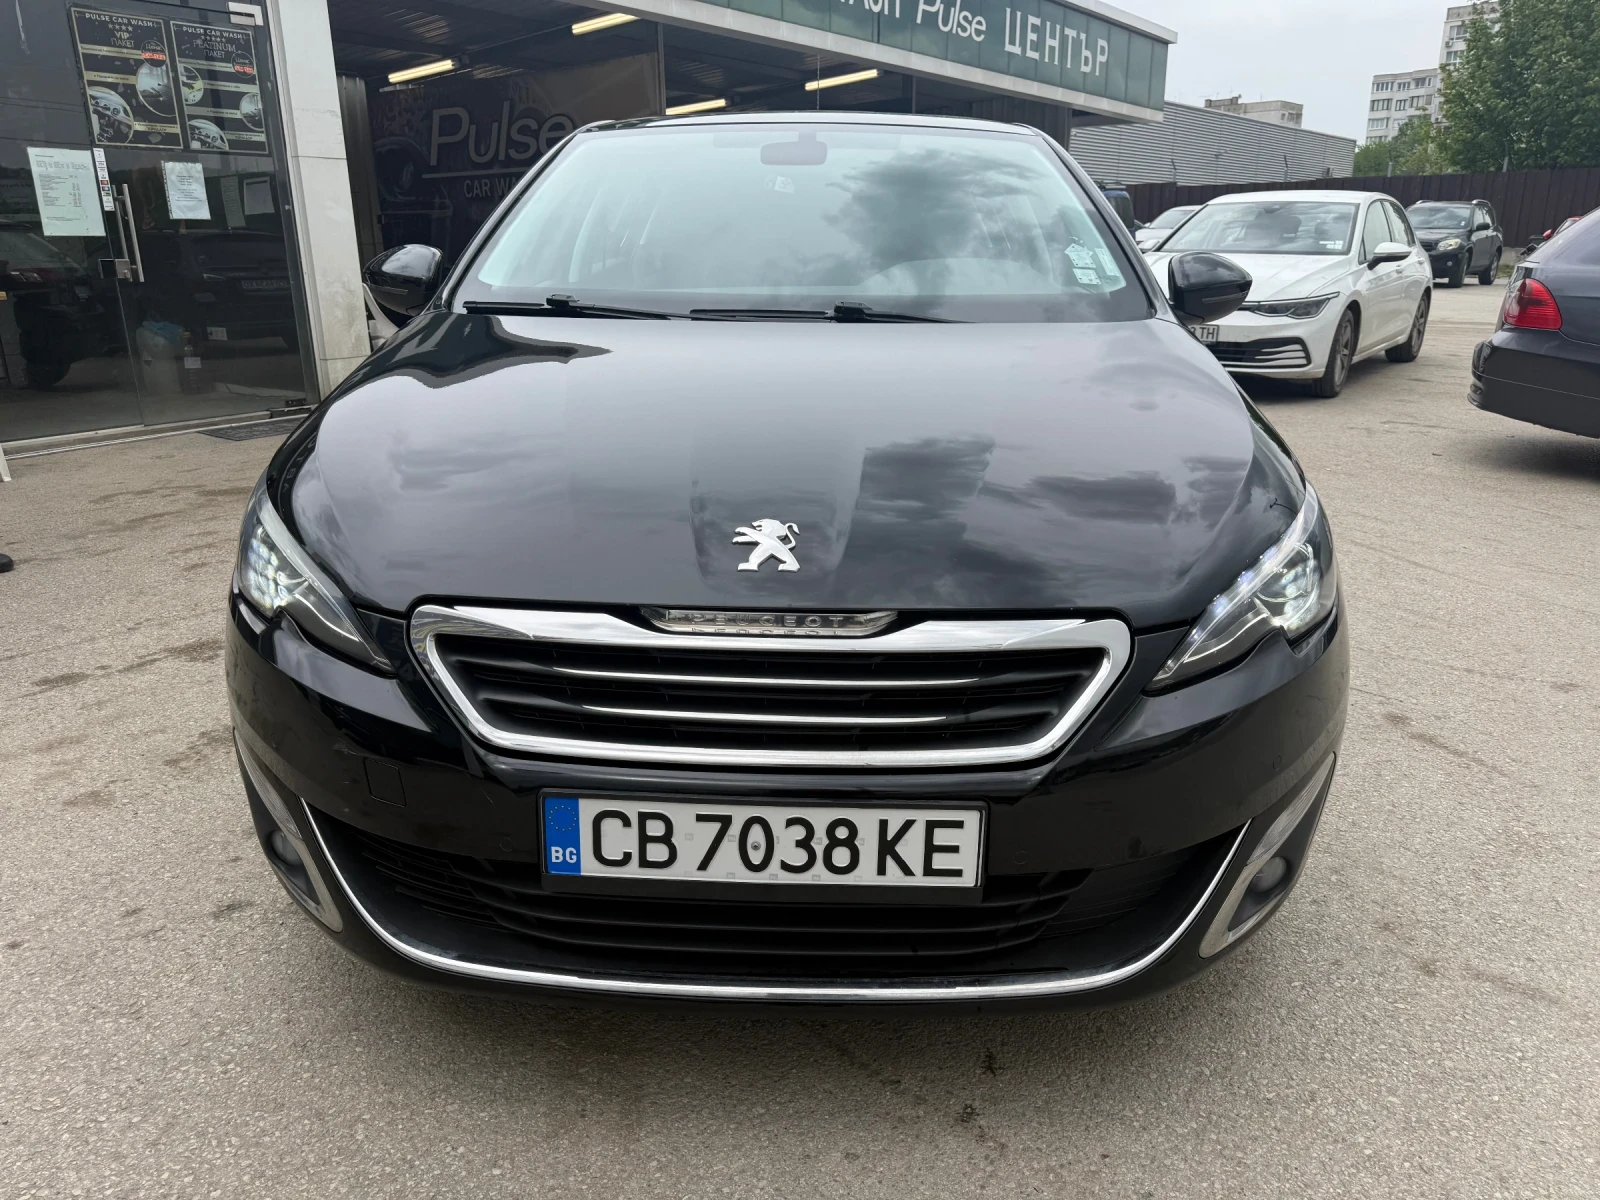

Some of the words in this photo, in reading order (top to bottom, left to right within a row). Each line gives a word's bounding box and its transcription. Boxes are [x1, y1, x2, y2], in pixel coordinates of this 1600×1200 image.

[85, 13, 110, 22] PULSE
[112, 16, 128, 24] CAR
[130, 19, 153, 27] WASH
[114, 30, 130, 39] VIP
[182, 26, 205, 35] PULSE
[206, 29, 221, 37] CAR
[222, 31, 242, 39] WASH
[916, 0, 987, 42] Pulse
[1004, 7, 1110, 77] ЦЕНТЪР
[111, 38, 135, 48] ПАКЕТ
[193, 39, 237, 52] PLATINUM
[203, 49, 225, 59] ПАКЕТ
[430, 101, 575, 167] Pulse
[464, 178, 491, 199] CAR
[495, 177, 522, 198] WA
[1199, 326, 1216, 340] TH
[691, 614, 843, 628] PEUGEOT
[591, 808, 678, 869] CB
[695, 813, 861, 875] 7038
[876, 818, 965, 878] KE
[550, 846, 577, 864] BG
